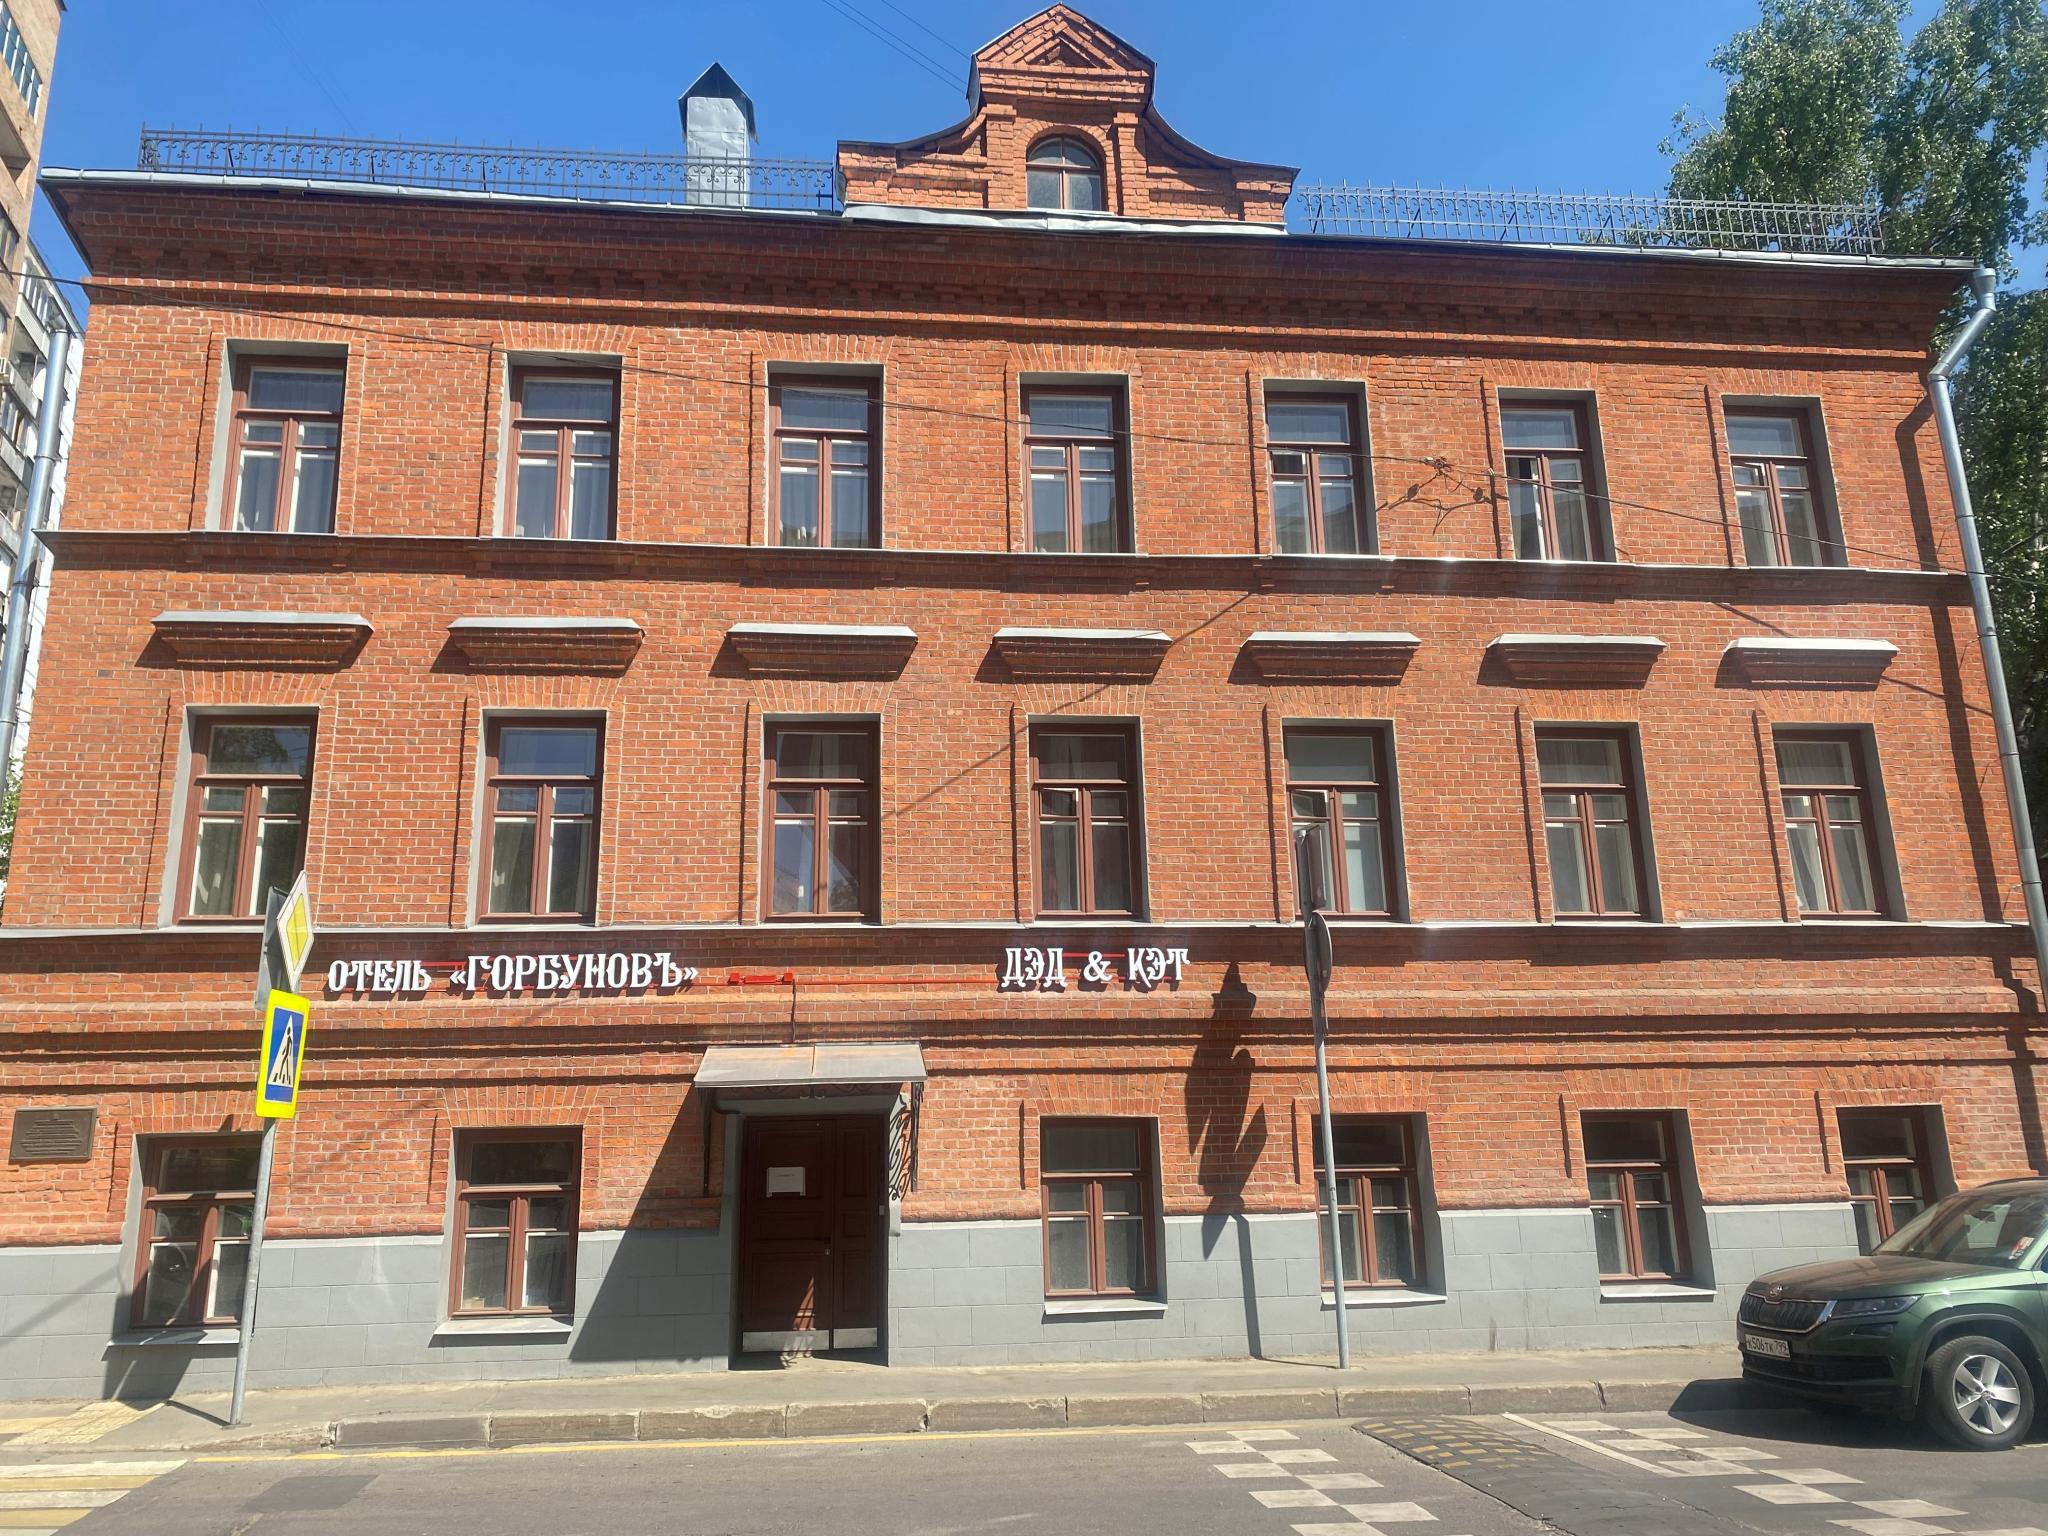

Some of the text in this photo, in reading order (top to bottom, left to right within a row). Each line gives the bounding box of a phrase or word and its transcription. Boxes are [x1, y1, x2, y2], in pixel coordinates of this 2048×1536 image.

[327, 952, 699, 993] ОТЕЛЬ «ГОРБУНОВЪ»
[1001, 947, 1190, 988] ДЭД & КЭТ
